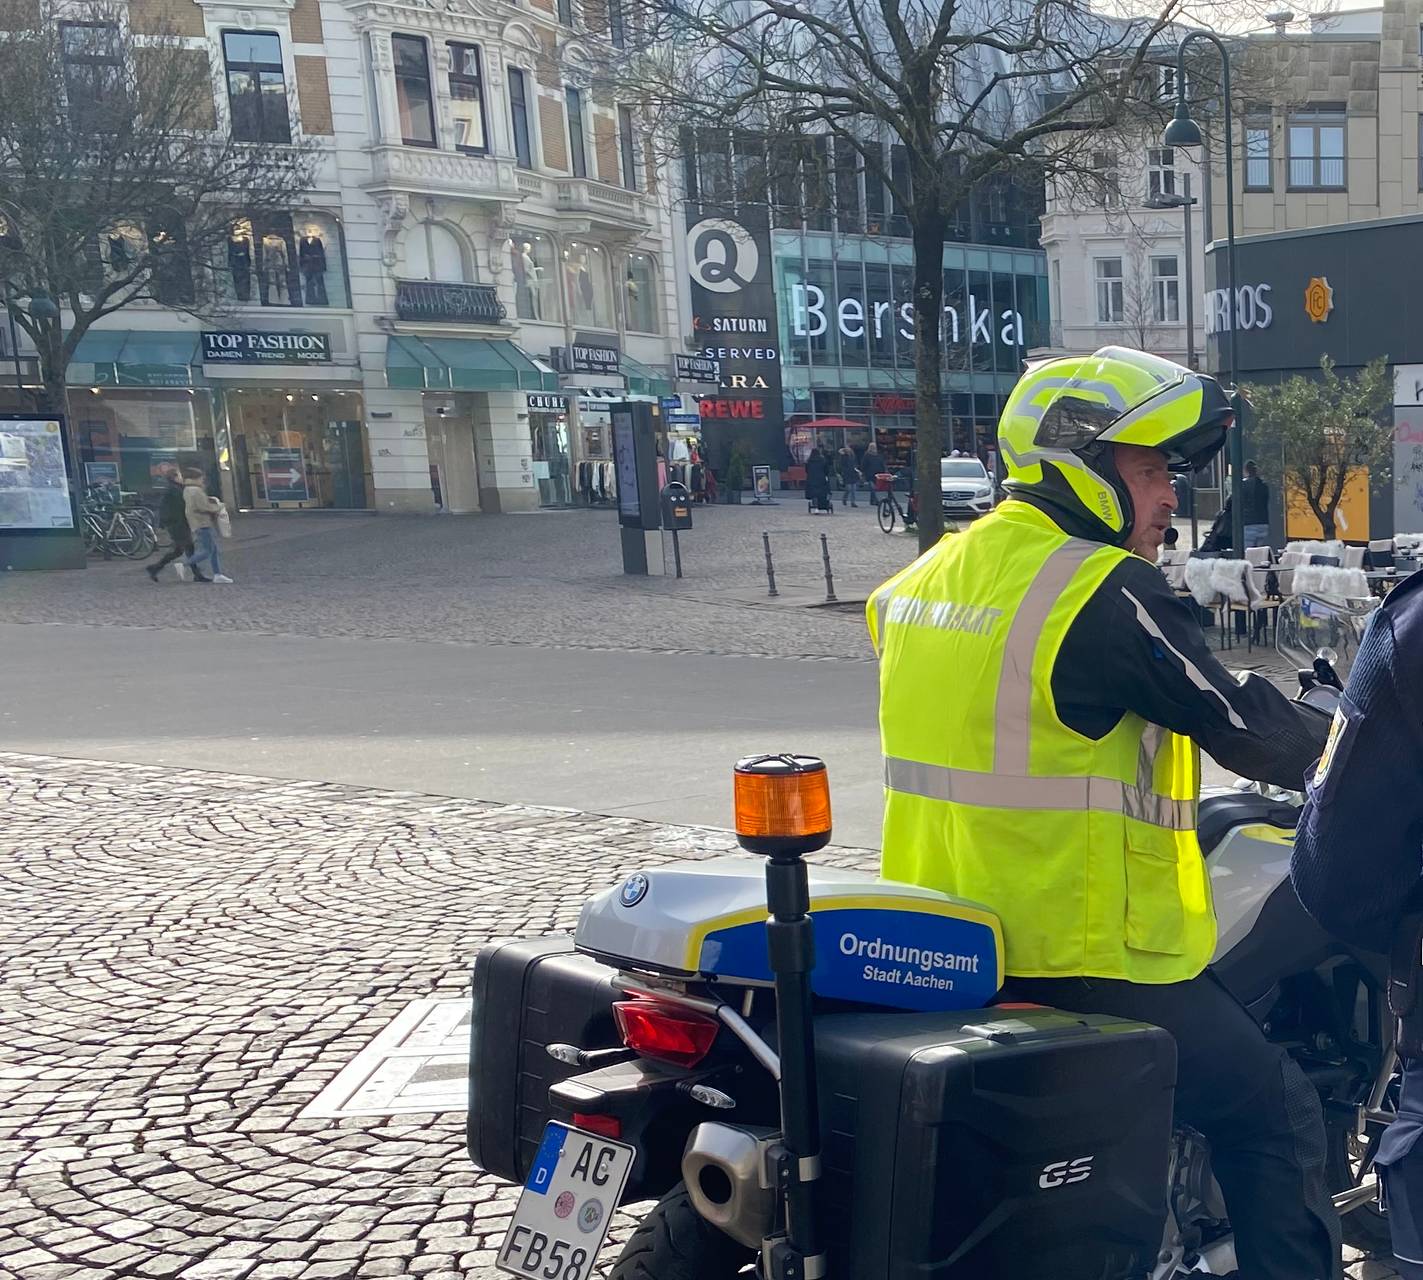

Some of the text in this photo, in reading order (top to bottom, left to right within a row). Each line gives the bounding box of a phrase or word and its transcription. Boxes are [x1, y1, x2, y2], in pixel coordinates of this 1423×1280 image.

[713, 318, 767, 332] SATURN
[204, 334, 325, 350] TOP FASHION
[207, 350, 326, 360] DAMEN TREND MODE
[574, 347, 617, 362] TOP FASHION
[695, 348, 776, 360] SERVED
[720, 375, 769, 388] RA
[699, 400, 764, 419] REWE
[1098, 491, 1113, 520] BMW
[839, 933, 979, 973] Ordnungsamt
[863, 965, 954, 991] Stadt Aachen
[571, 1141, 616, 1186] AC
[1039, 1156, 1094, 1188] GS
[535, 1167, 548, 1185] D
[503, 1225, 587, 1280] FB58
